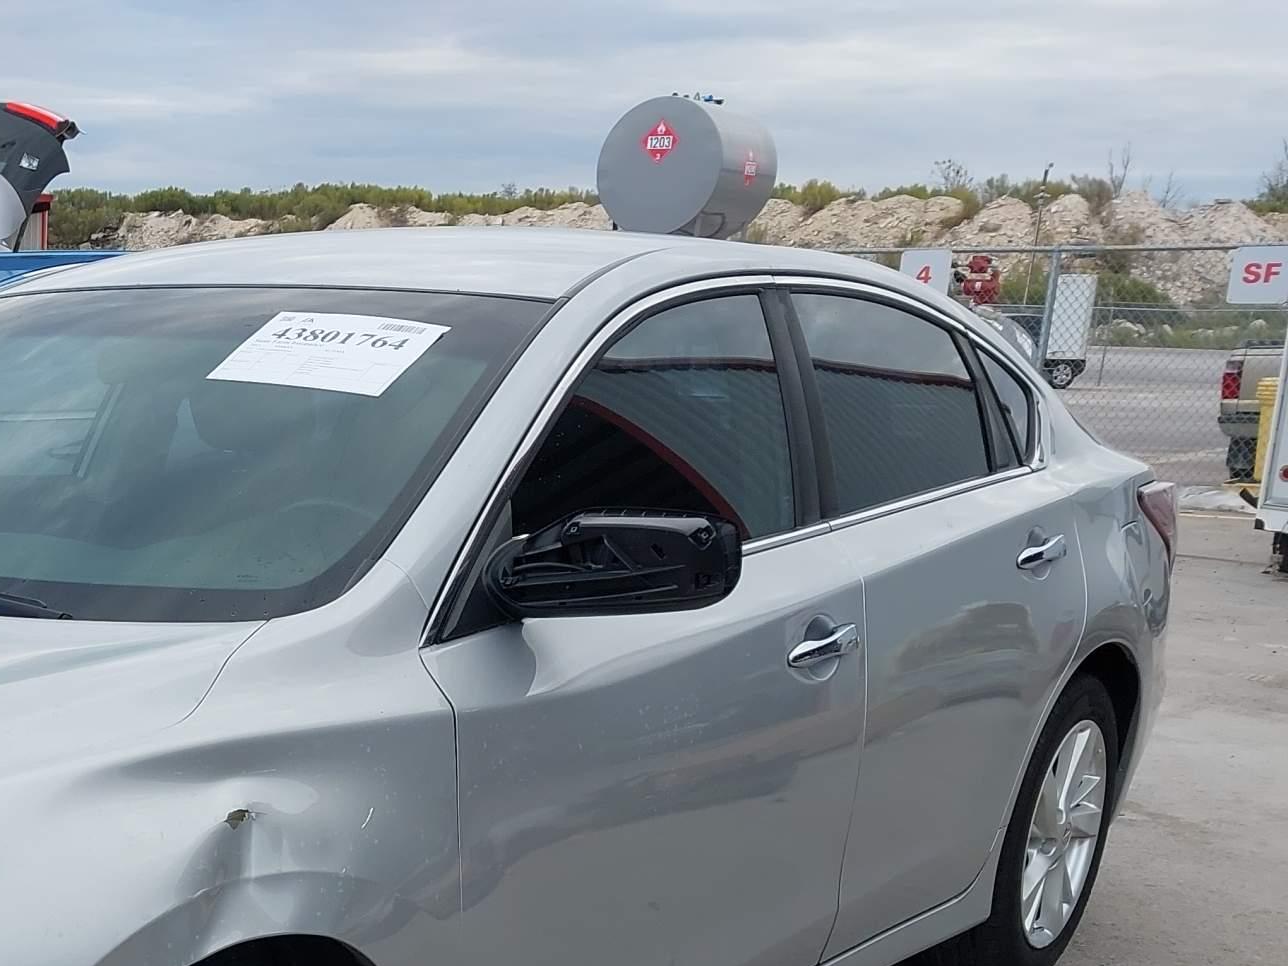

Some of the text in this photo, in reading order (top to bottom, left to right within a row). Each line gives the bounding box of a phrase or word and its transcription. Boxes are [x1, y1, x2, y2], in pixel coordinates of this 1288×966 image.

[649, 136, 672, 149] 1203
[915, 265, 932, 284] 4
[1242, 262, 1283, 284] SF
[272, 327, 409, 350] 43801764
